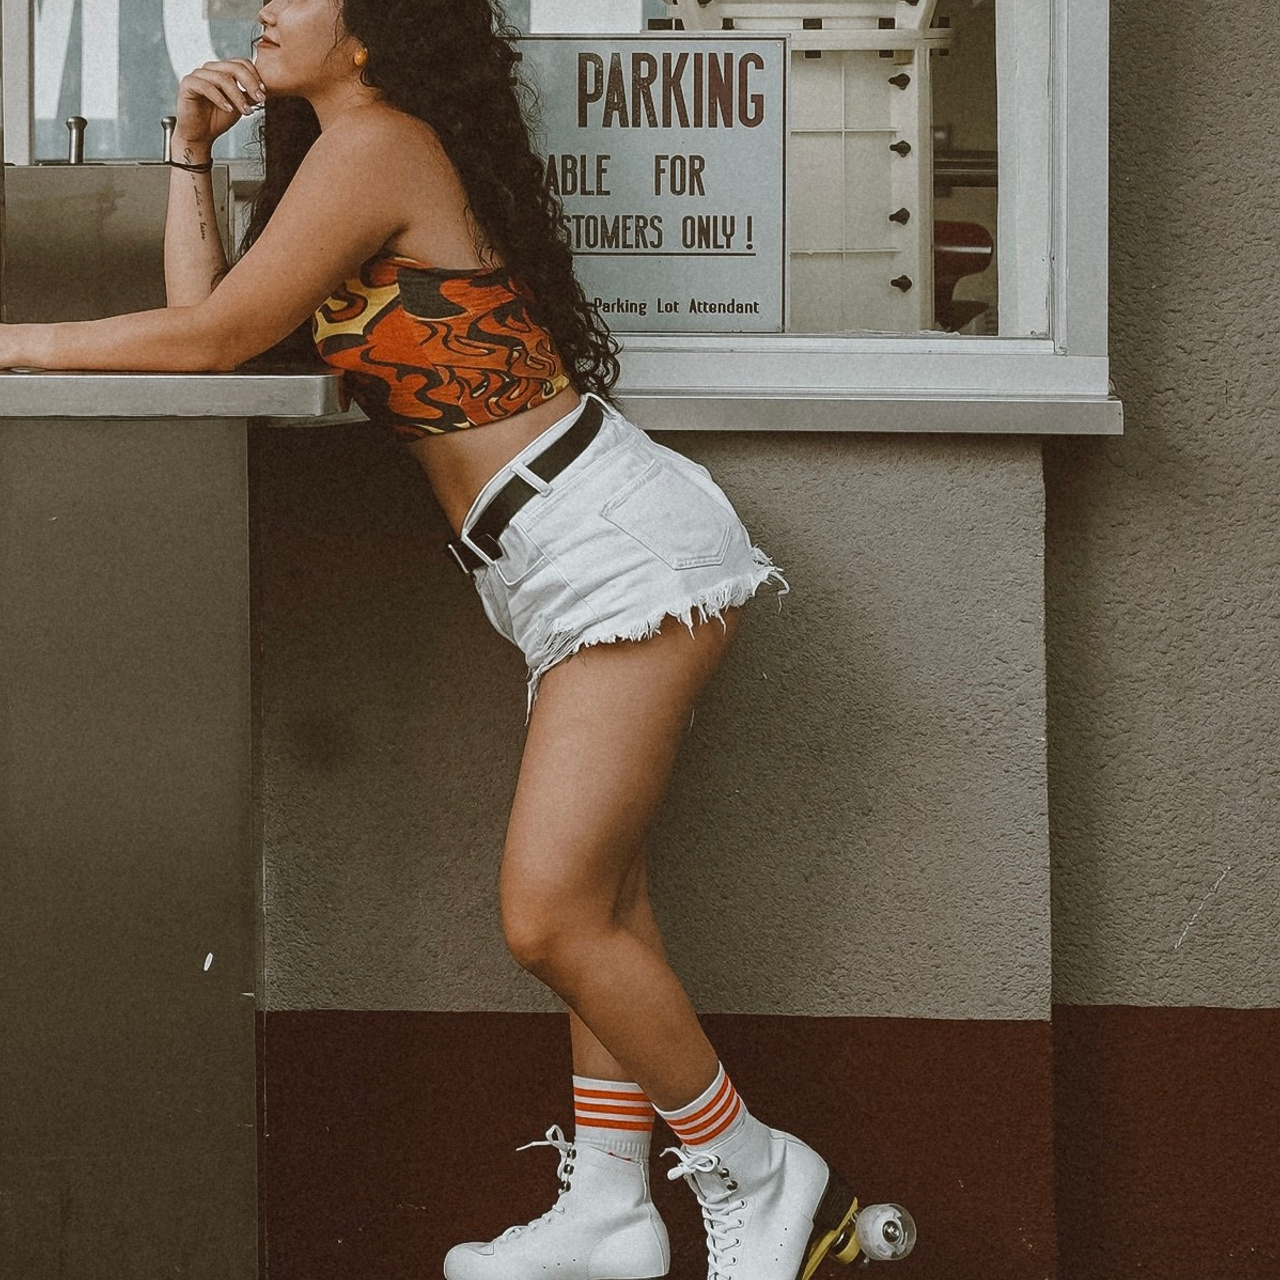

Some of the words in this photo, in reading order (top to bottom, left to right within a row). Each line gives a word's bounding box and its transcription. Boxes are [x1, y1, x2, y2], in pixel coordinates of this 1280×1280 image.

[578, 52, 764, 128] PARKING
[544, 154, 611, 196] ABLE
[654, 155, 706, 196] FOR
[562, 215, 663, 250] STOMERS
[594, 297, 648, 317] Parking
[657, 297, 680, 314] Lot
[689, 298, 760, 315] Attendant
